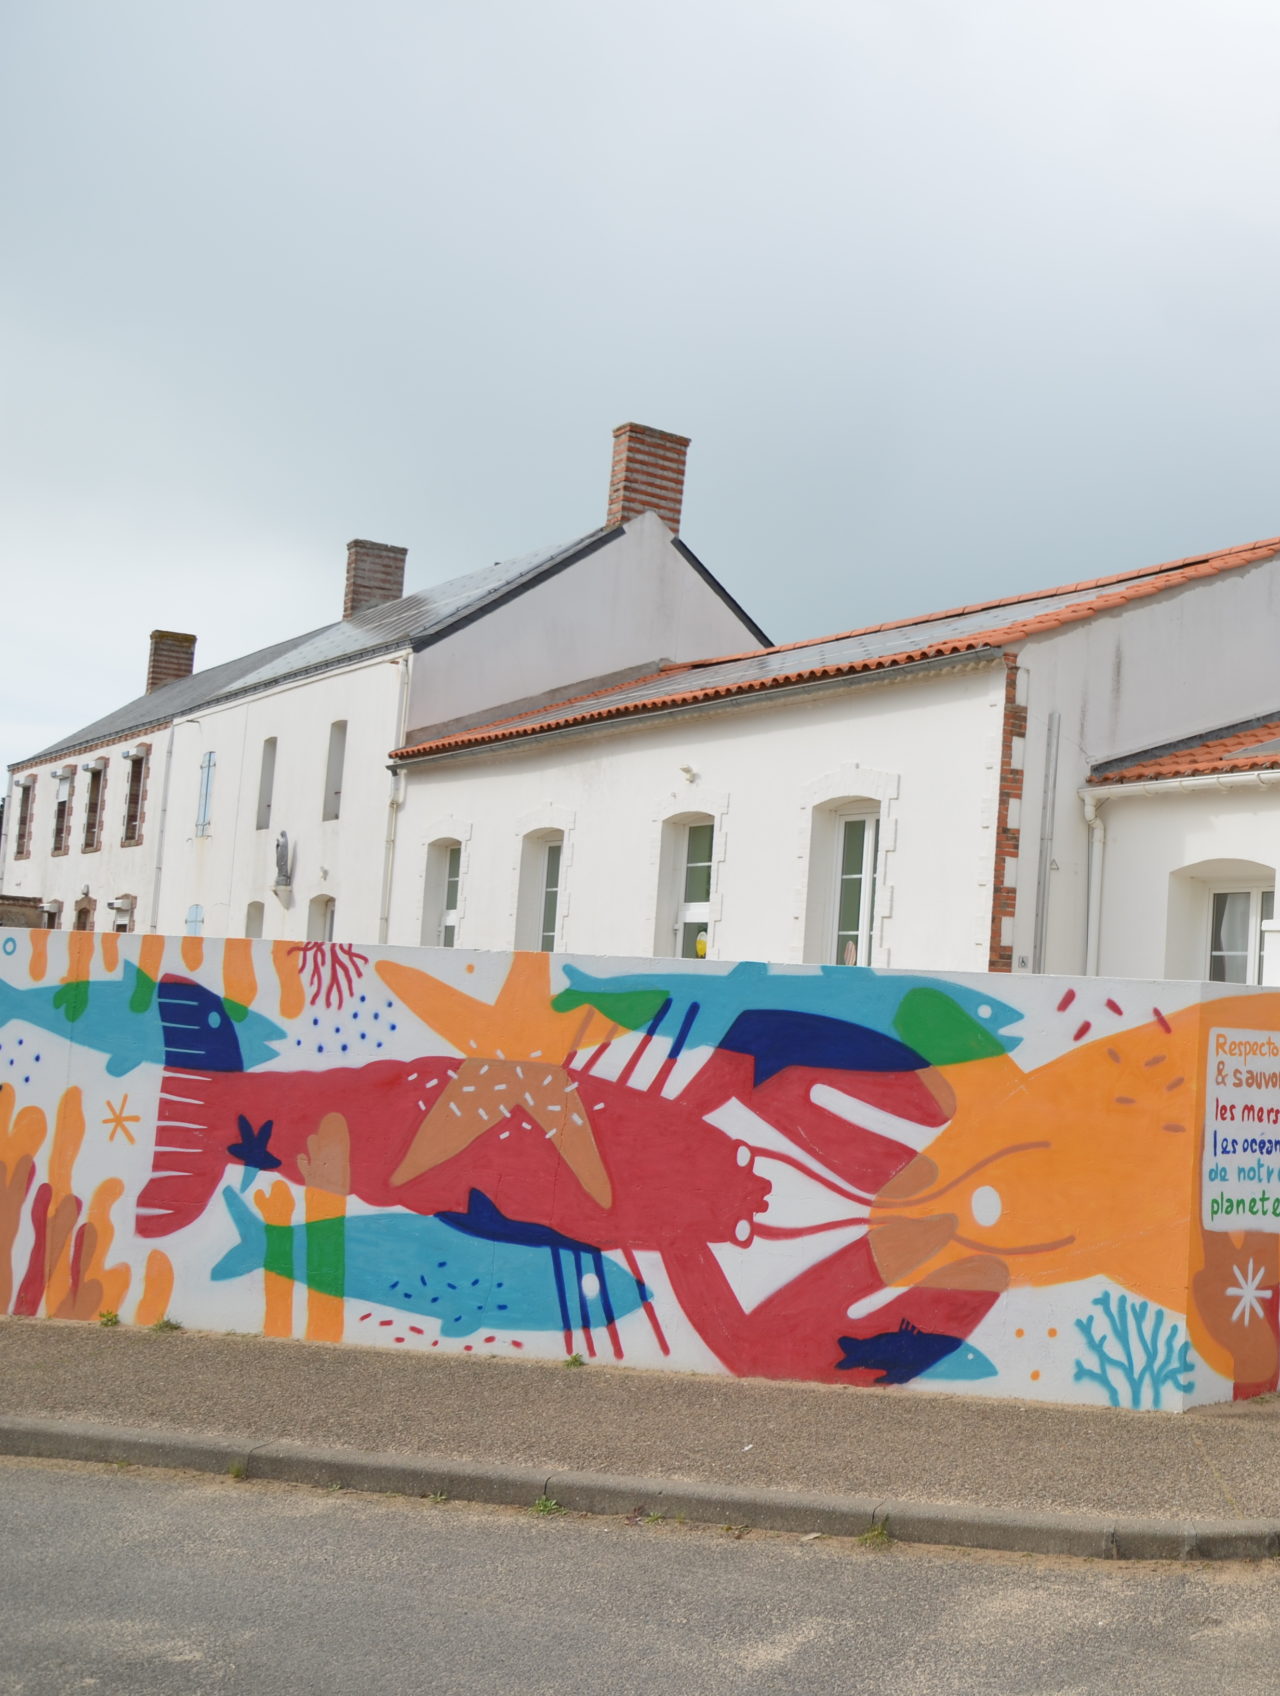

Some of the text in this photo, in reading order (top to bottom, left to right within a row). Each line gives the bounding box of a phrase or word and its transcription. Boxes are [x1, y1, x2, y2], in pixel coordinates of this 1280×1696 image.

[1215, 1060, 1229, 1087] &
[1215, 1097, 1236, 1121] les
[1213, 1130, 1238, 1157] les
[1208, 1163, 1229, 1182] de
